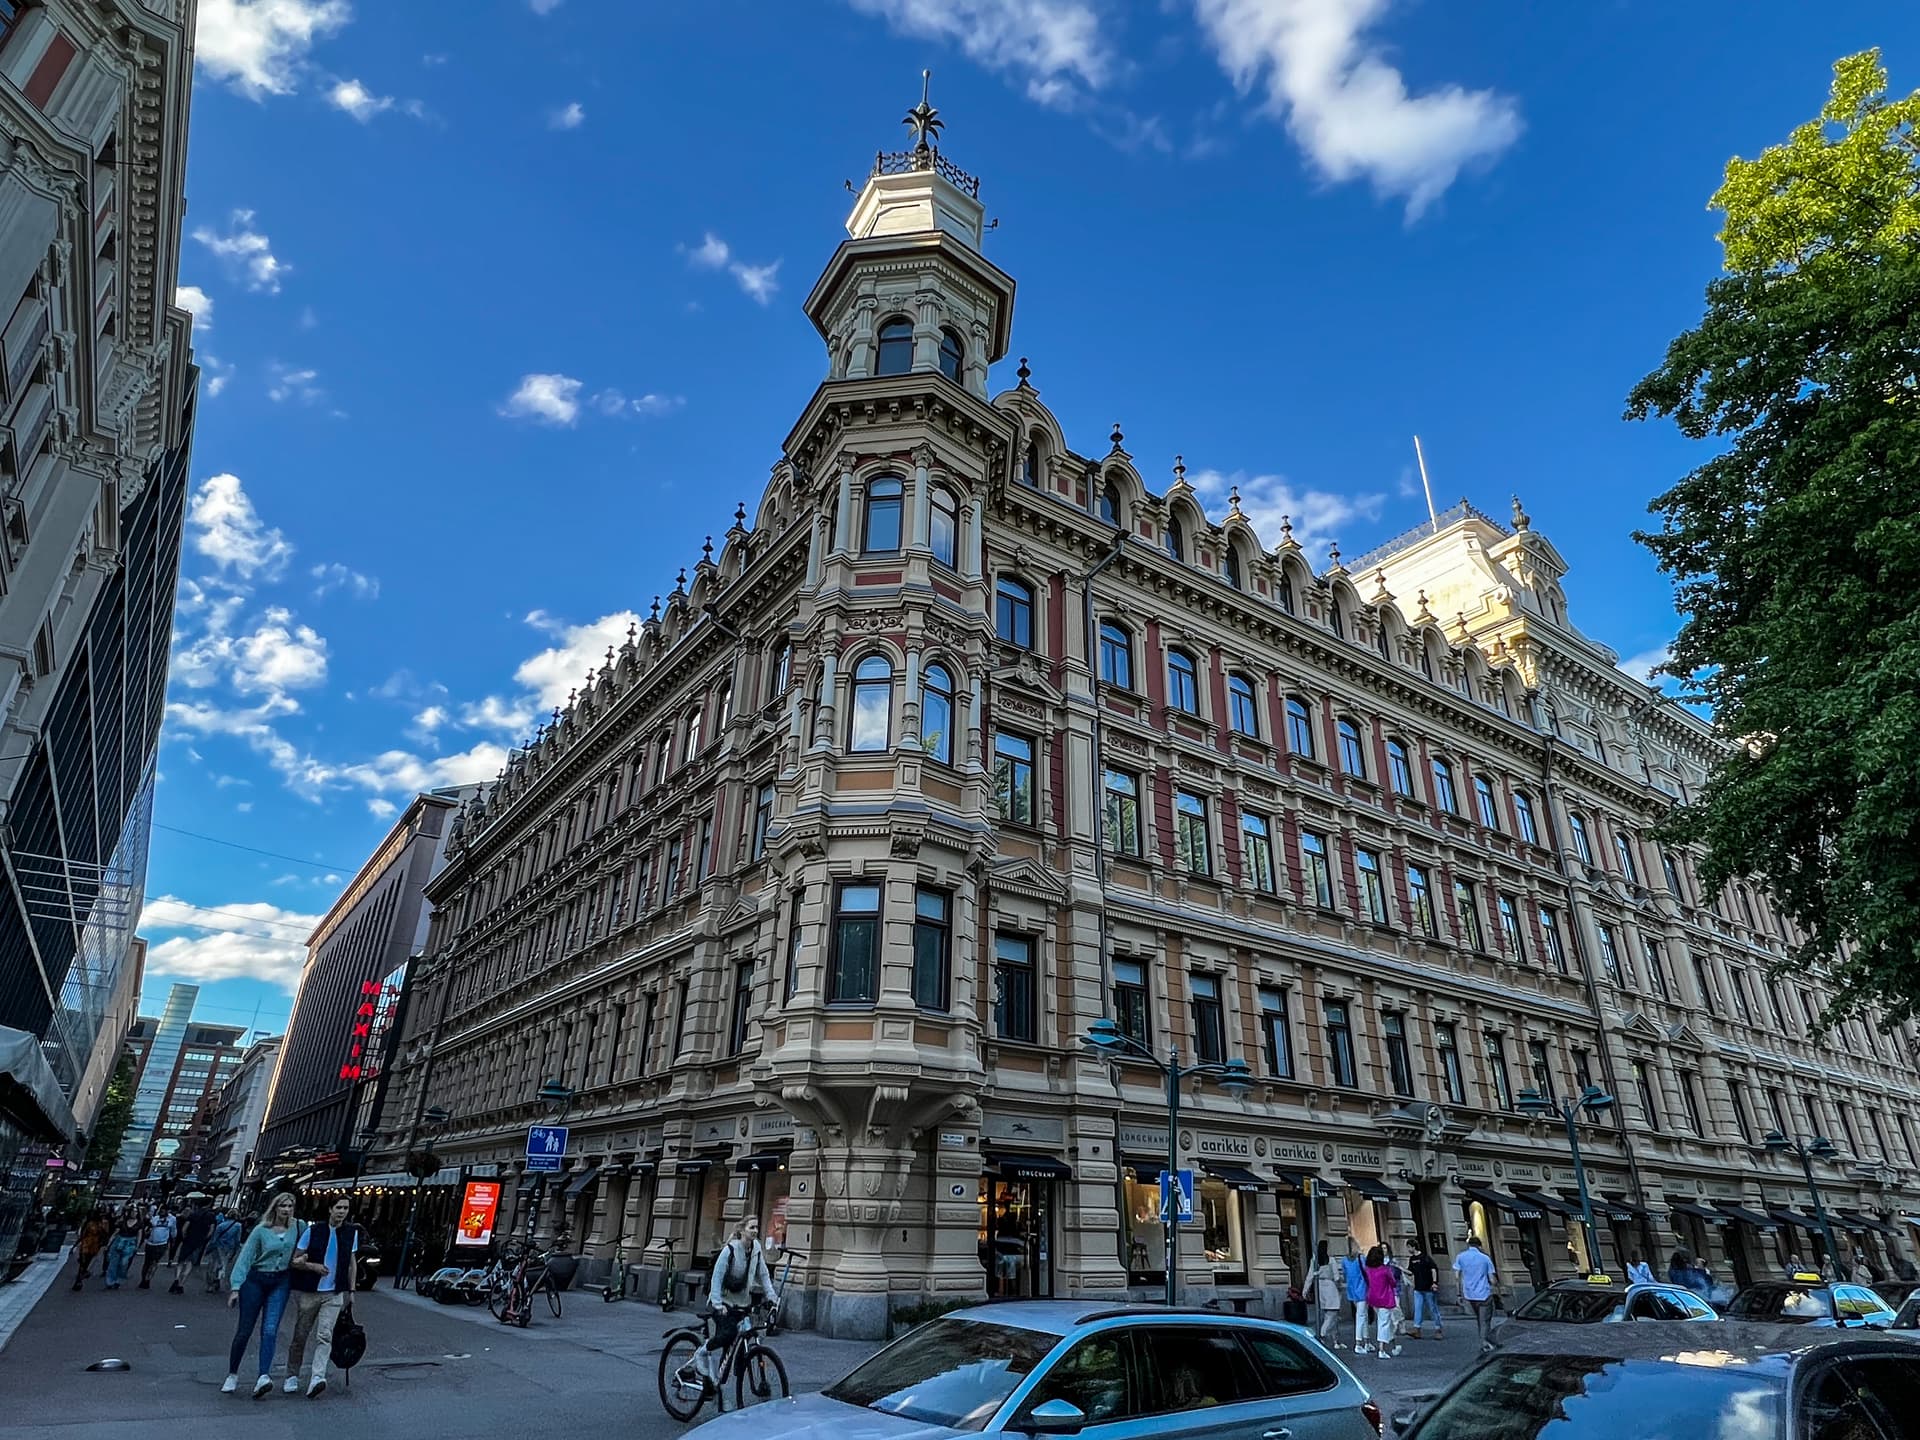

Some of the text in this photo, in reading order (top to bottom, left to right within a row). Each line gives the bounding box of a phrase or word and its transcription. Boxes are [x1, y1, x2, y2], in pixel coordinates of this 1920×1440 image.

[340, 980, 382, 1079] MAXIM
[1202, 1138, 1248, 1154] aarikka
[1275, 1145, 1317, 1160] aarikka
[1341, 1152, 1380, 1165] aarikka
[1018, 1169, 1055, 1178] LONGCHAMP
[1518, 1211, 1541, 1219] LUXBAG
